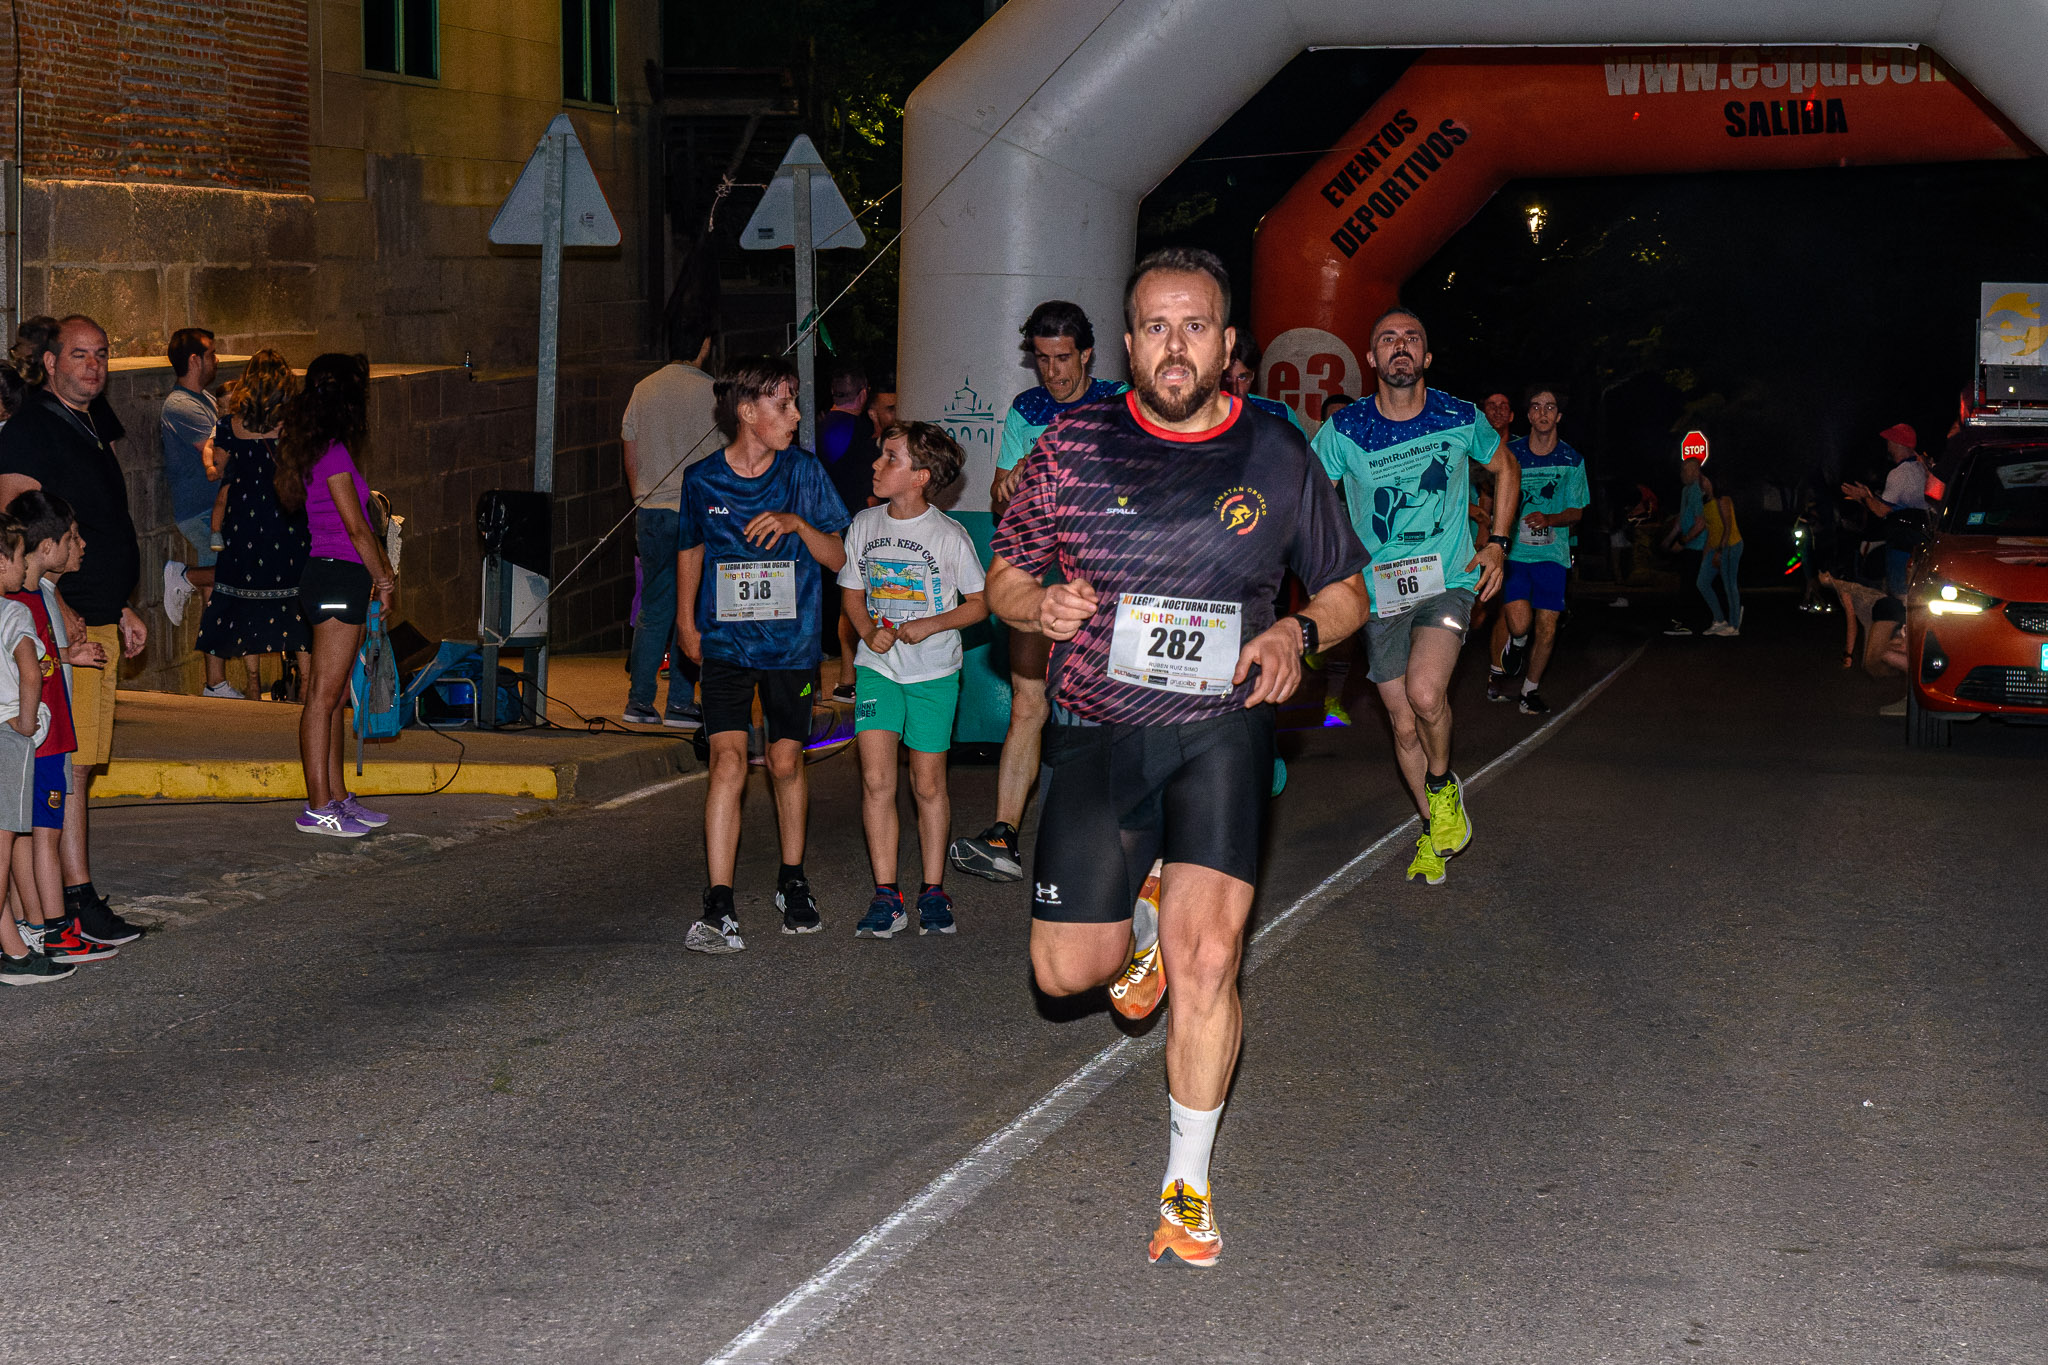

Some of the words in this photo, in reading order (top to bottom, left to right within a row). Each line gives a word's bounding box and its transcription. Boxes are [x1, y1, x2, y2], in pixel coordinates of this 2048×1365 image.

[1723, 98, 1849, 138] SALIDA
[1320, 109, 1418, 209] EVENTOS
[1330, 118, 1467, 259] DEPORTIVOS
[1267, 353, 1346, 422] e3
[1368, 442, 1440, 469] NightRunMusic
[1684, 445, 1705, 456] STOP
[708, 506, 730, 515] FILA
[1213, 486, 1244, 511] JONATAN
[741, 562, 772, 570] NOCTNA
[897, 538, 923, 552] KEEP
[922, 550, 940, 575] CALM
[739, 580, 772, 600] 318
[1397, 575, 1419, 596] 66
[1122, 594, 1133, 605] XI
[1132, 596, 1160, 608] LEGUA
[1162, 599, 1208, 613] NOCTURNA
[1209, 603, 1237, 615] UGENA
[1147, 627, 1206, 662] 282
[1169, 664, 1183, 672] RUIZ
